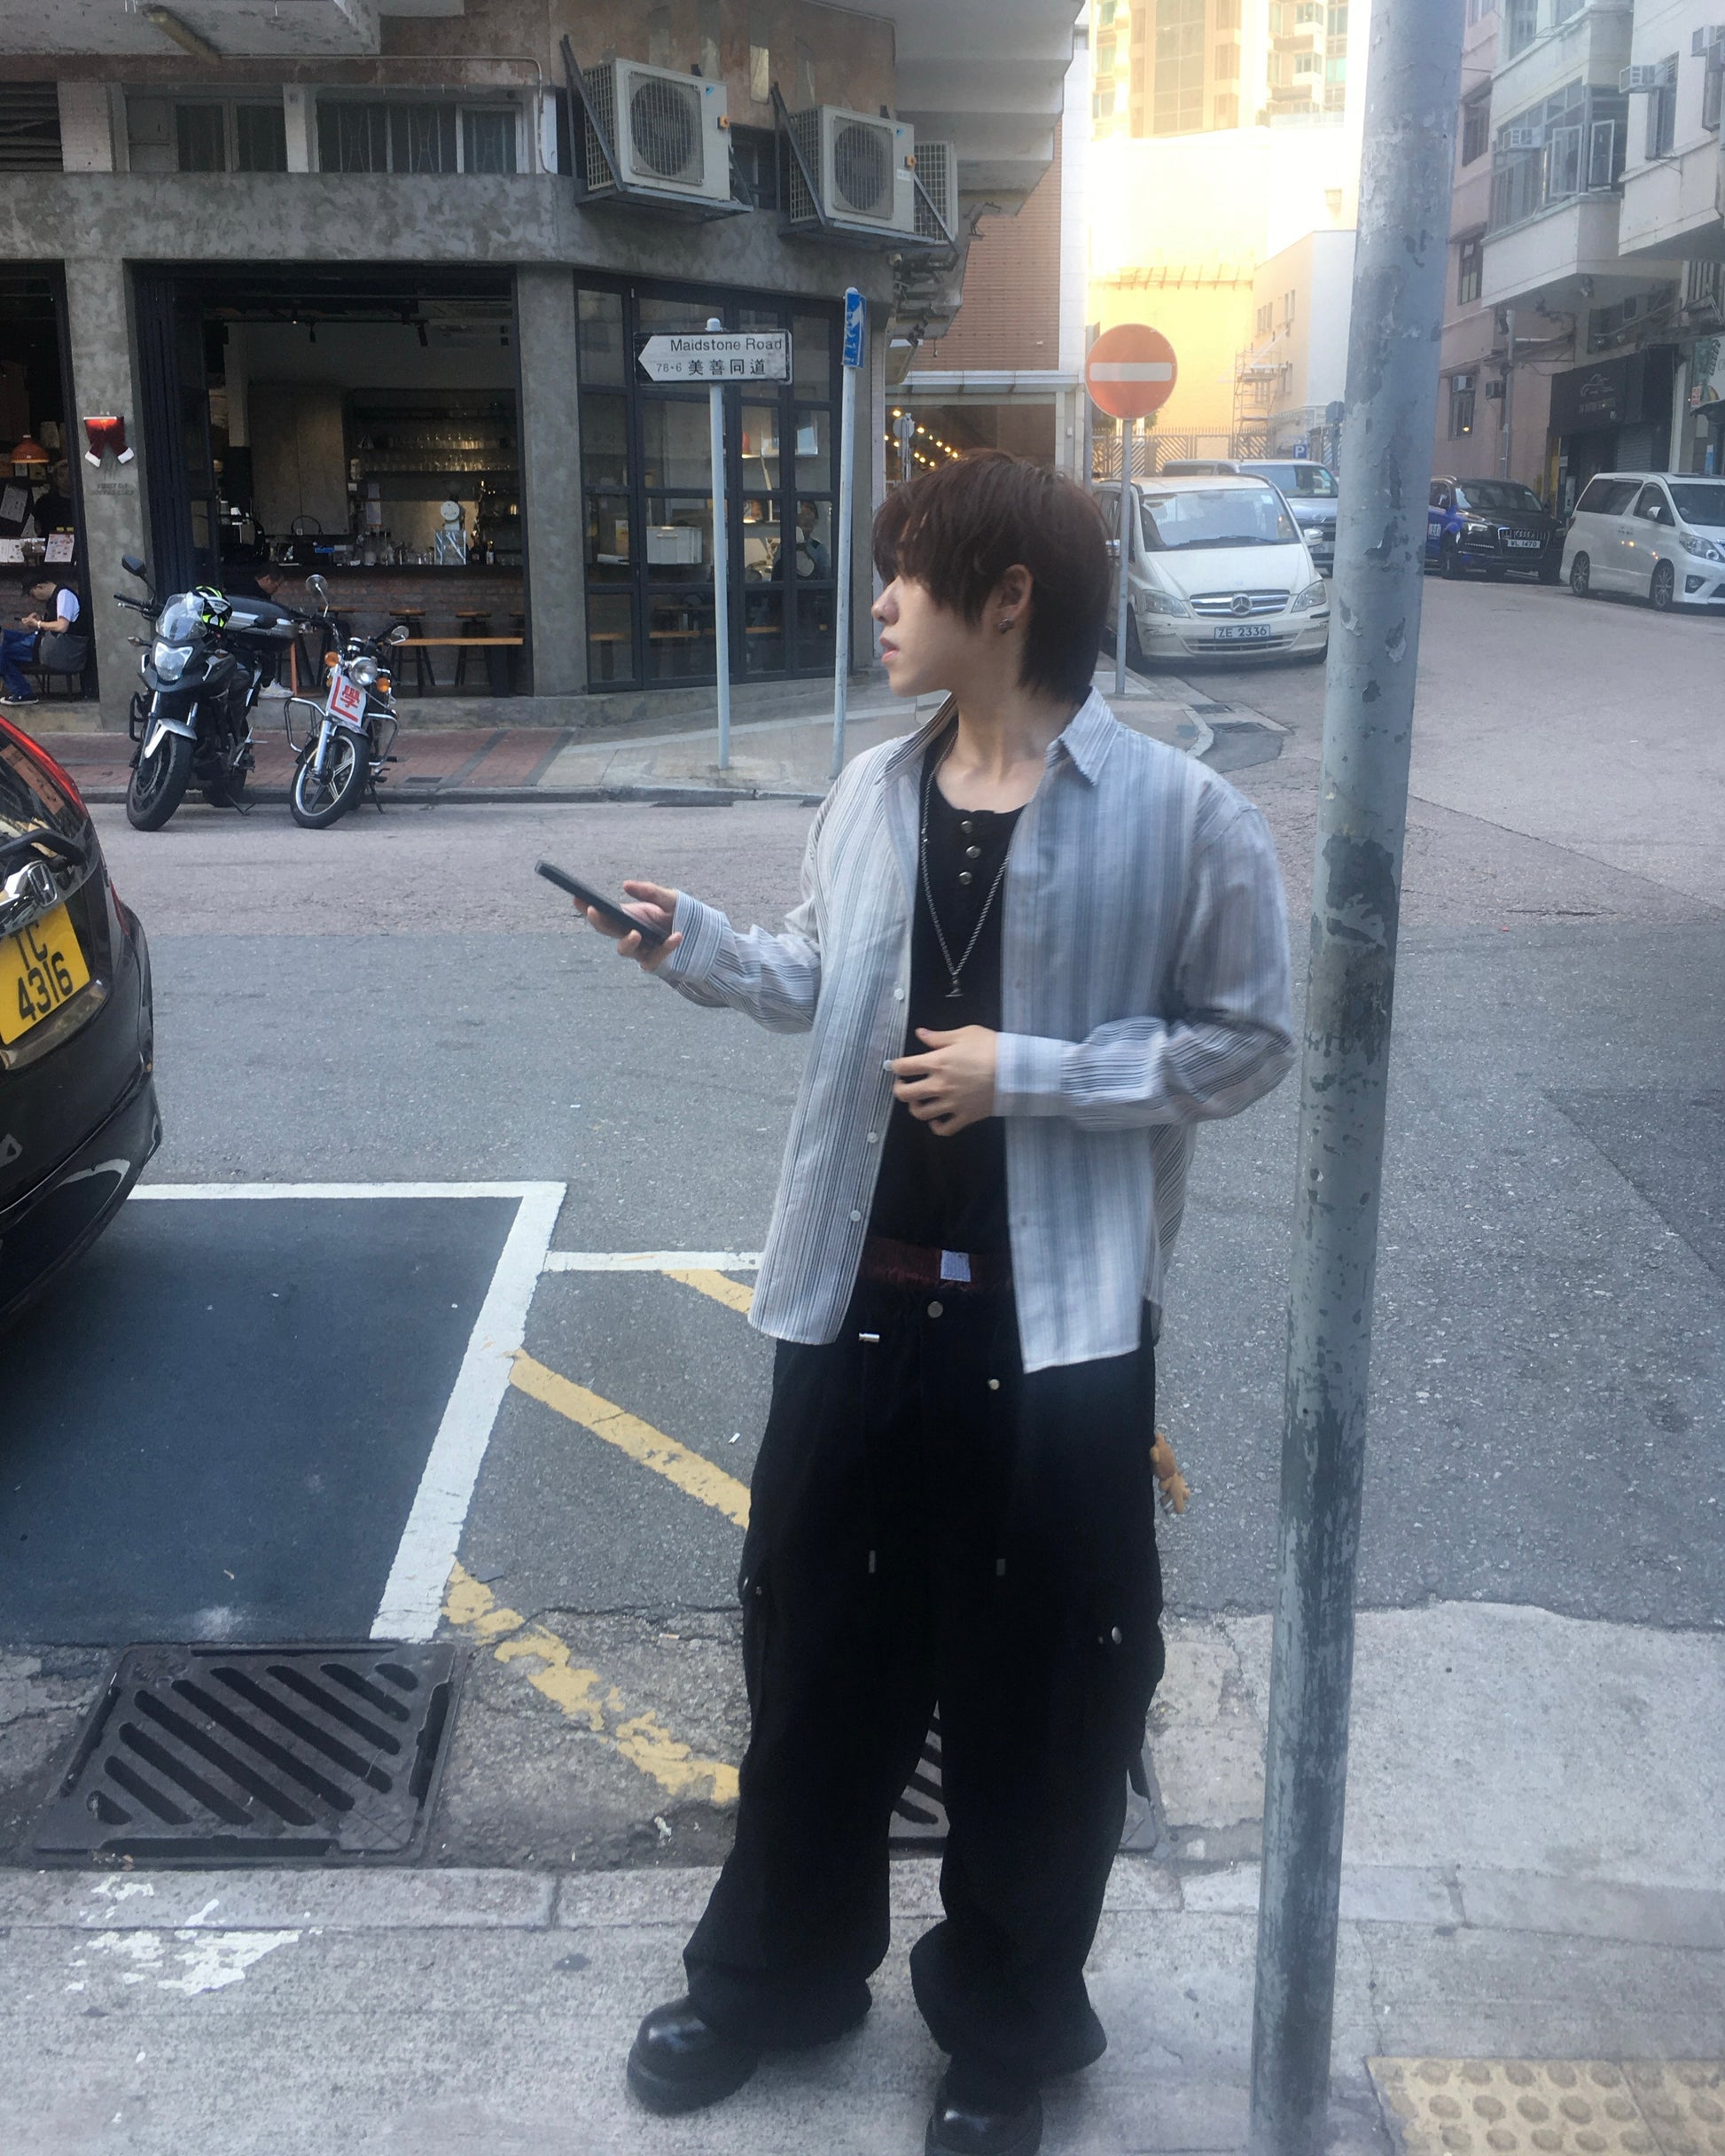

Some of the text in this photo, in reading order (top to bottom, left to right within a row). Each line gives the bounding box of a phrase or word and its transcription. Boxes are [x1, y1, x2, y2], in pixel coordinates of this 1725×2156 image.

[670, 338, 783, 352] Maidstone Road
[688, 359, 766, 376] 美善同道
[1295, 445, 1305, 458] P
[1218, 626, 1268, 638] ZE 2336
[340, 685, 361, 708] 學
[9, 919, 48, 971] TC
[18, 951, 73, 1021] 4316
